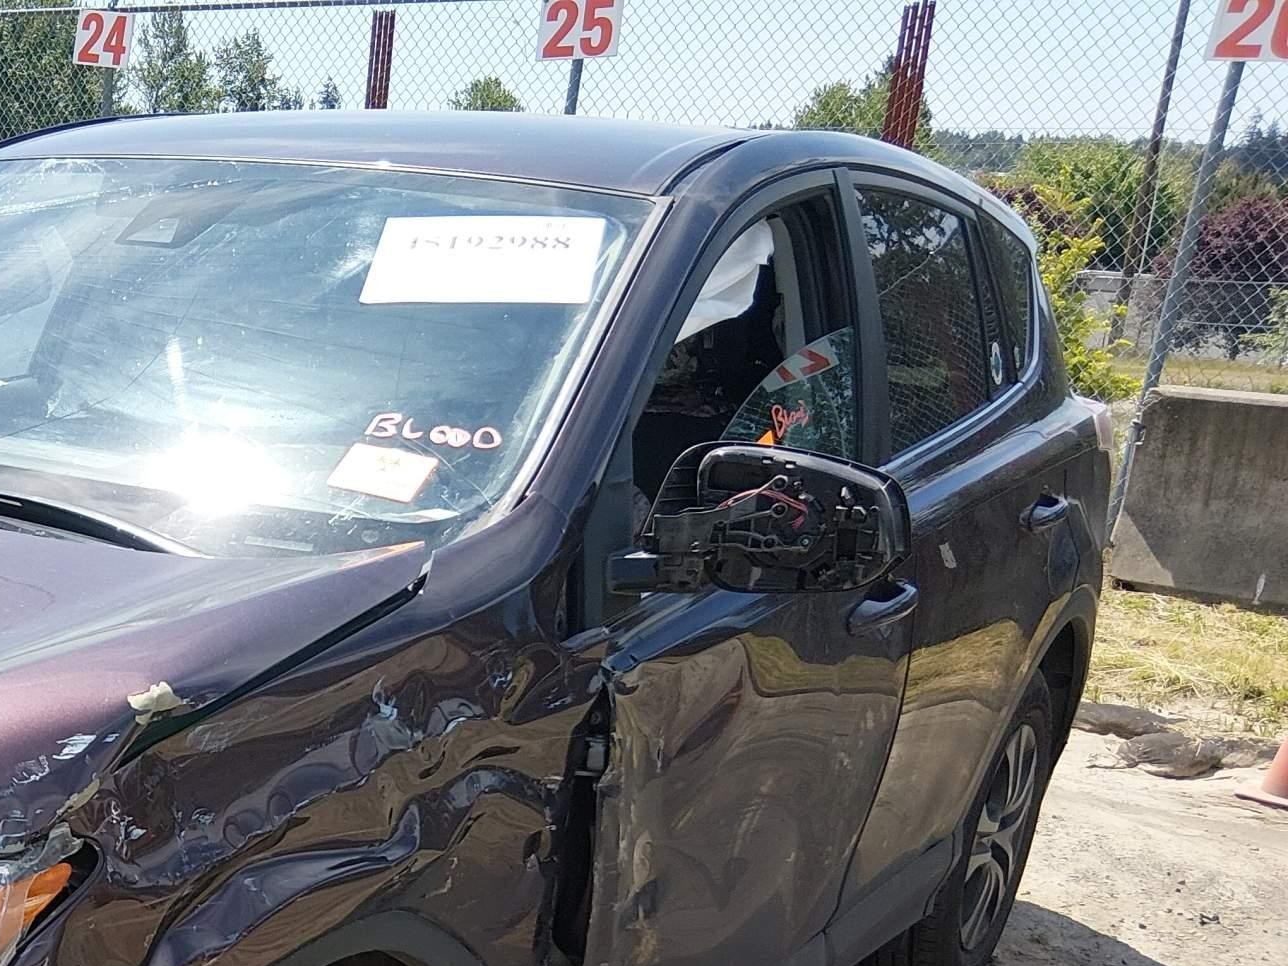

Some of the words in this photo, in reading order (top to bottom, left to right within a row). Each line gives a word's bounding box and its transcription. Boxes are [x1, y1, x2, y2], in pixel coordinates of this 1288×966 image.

[78, 12, 127, 65] 24
[542, 0, 614, 57] 25
[364, 412, 503, 449] BLOOD
